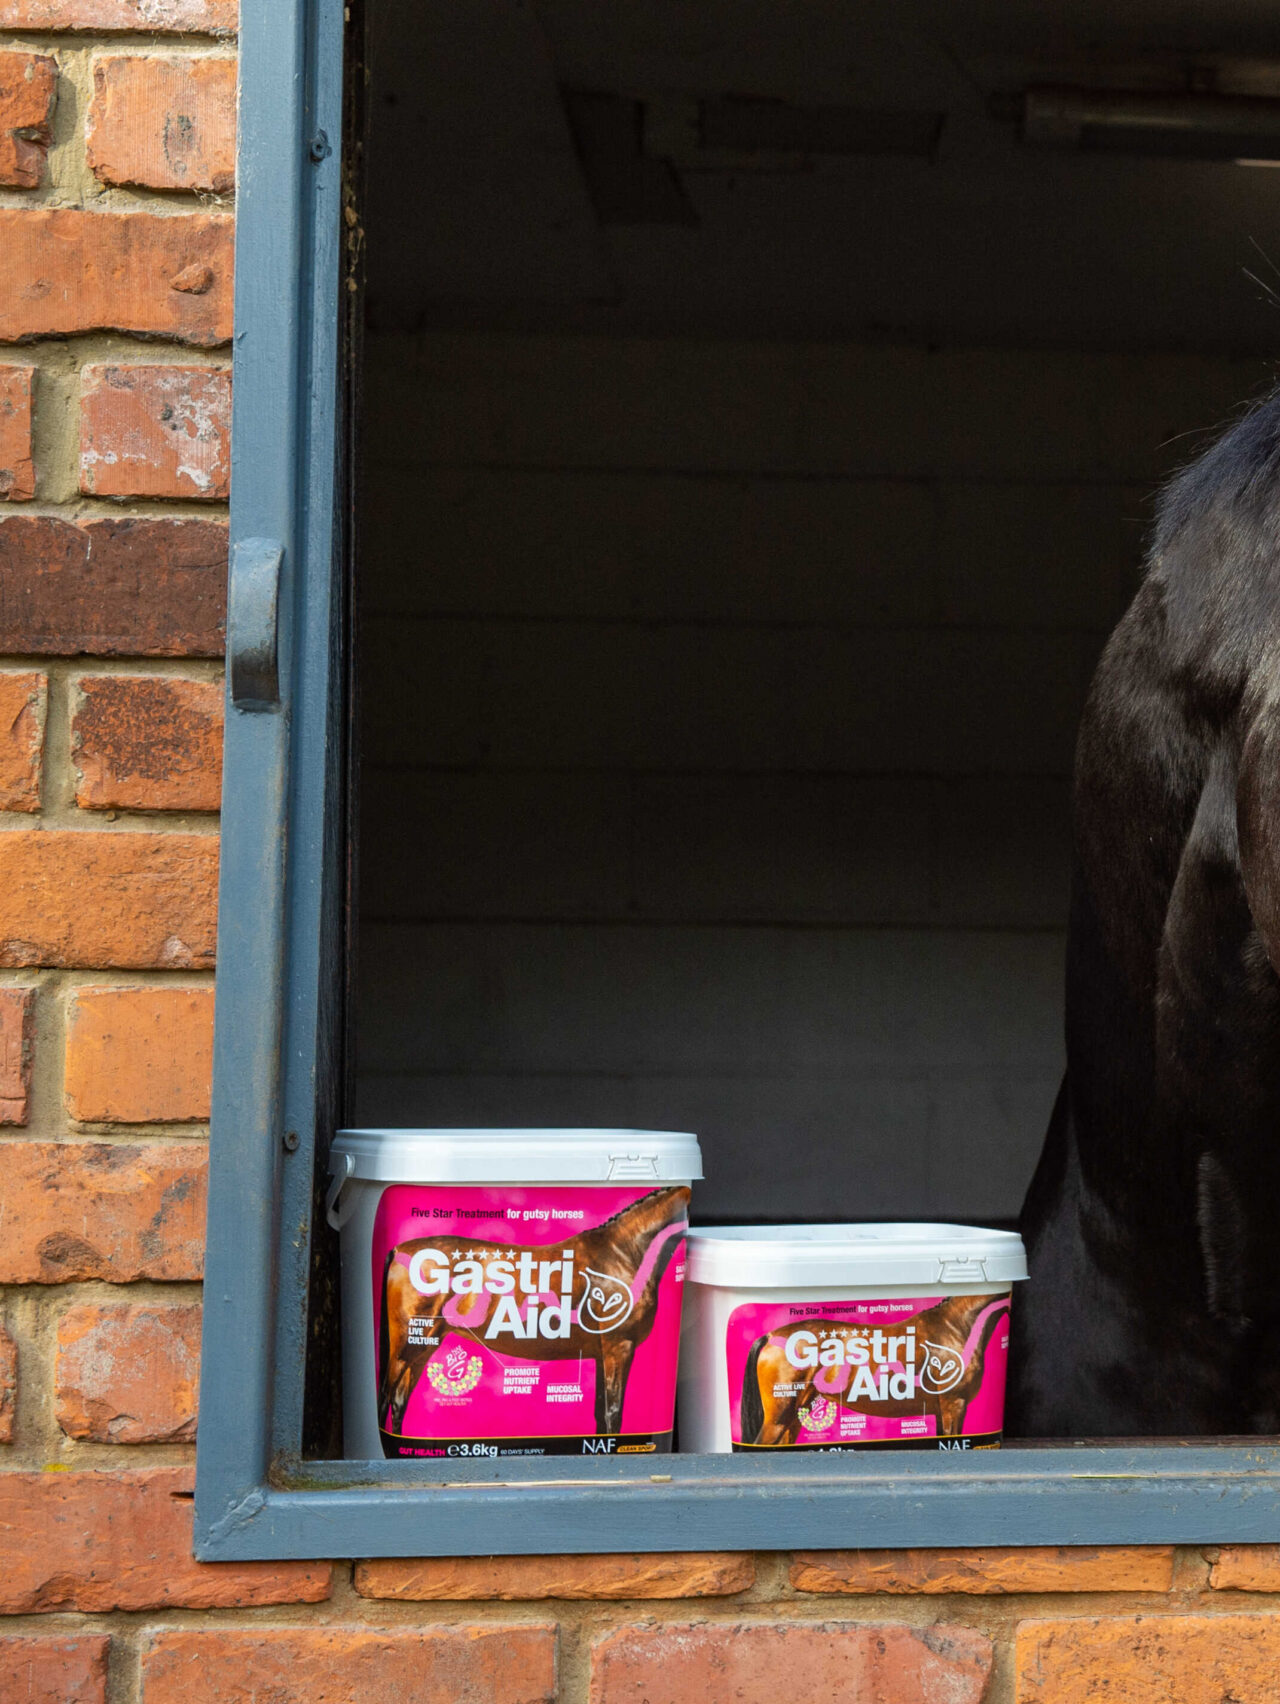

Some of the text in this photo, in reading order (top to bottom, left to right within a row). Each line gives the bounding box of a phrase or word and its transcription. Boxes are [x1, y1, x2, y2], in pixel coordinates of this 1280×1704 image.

[411, 1207, 584, 1221] Five Star Treatment for gutsy horses
[409, 1248, 574, 1295] Gastri
[789, 1302, 913, 1316] Five Star Treatment for gutsy horses
[408, 1318, 434, 1327] ACTIVE
[485, 1296, 572, 1339] Aid
[408, 1328, 423, 1336] LIVE
[408, 1336, 439, 1346] CULTURE
[785, 1326, 915, 1368] Gastri
[448, 1361, 465, 1379] G
[504, 1368, 540, 1377] PROMOTE
[503, 1377, 540, 1386] NUTRIENT
[847, 1364, 915, 1402] Aid
[503, 1385, 532, 1395] UPTAKE
[547, 1385, 582, 1394] MUCOSAL
[546, 1394, 583, 1403] INTEGRITY
[840, 1415, 866, 1423] PROMOTE
[840, 1422, 866, 1430] NUTRIENT
[582, 1438, 616, 1454] NAF
[399, 1447, 413, 1455] GUT
[415, 1448, 445, 1456] HEALTH
